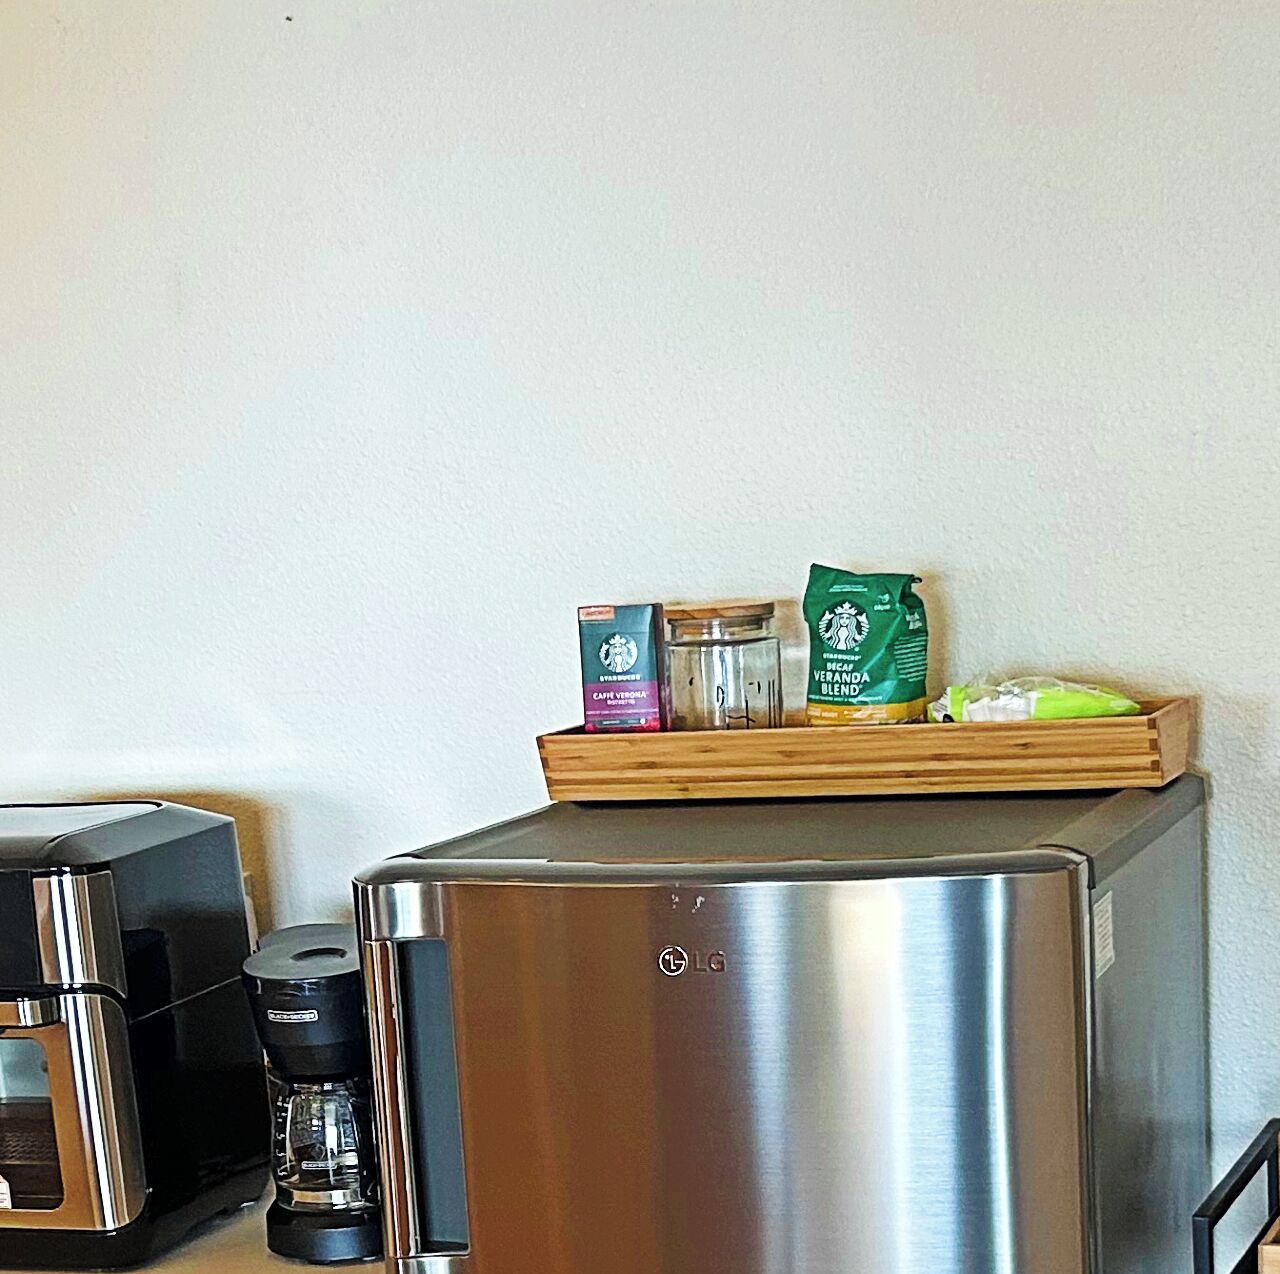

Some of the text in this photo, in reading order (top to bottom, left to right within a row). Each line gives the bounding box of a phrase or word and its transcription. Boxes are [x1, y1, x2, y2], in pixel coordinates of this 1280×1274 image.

[826, 662, 854, 671] DECAF
[814, 670, 870, 683] VERANDA
[821, 683, 860, 696] BLEND
